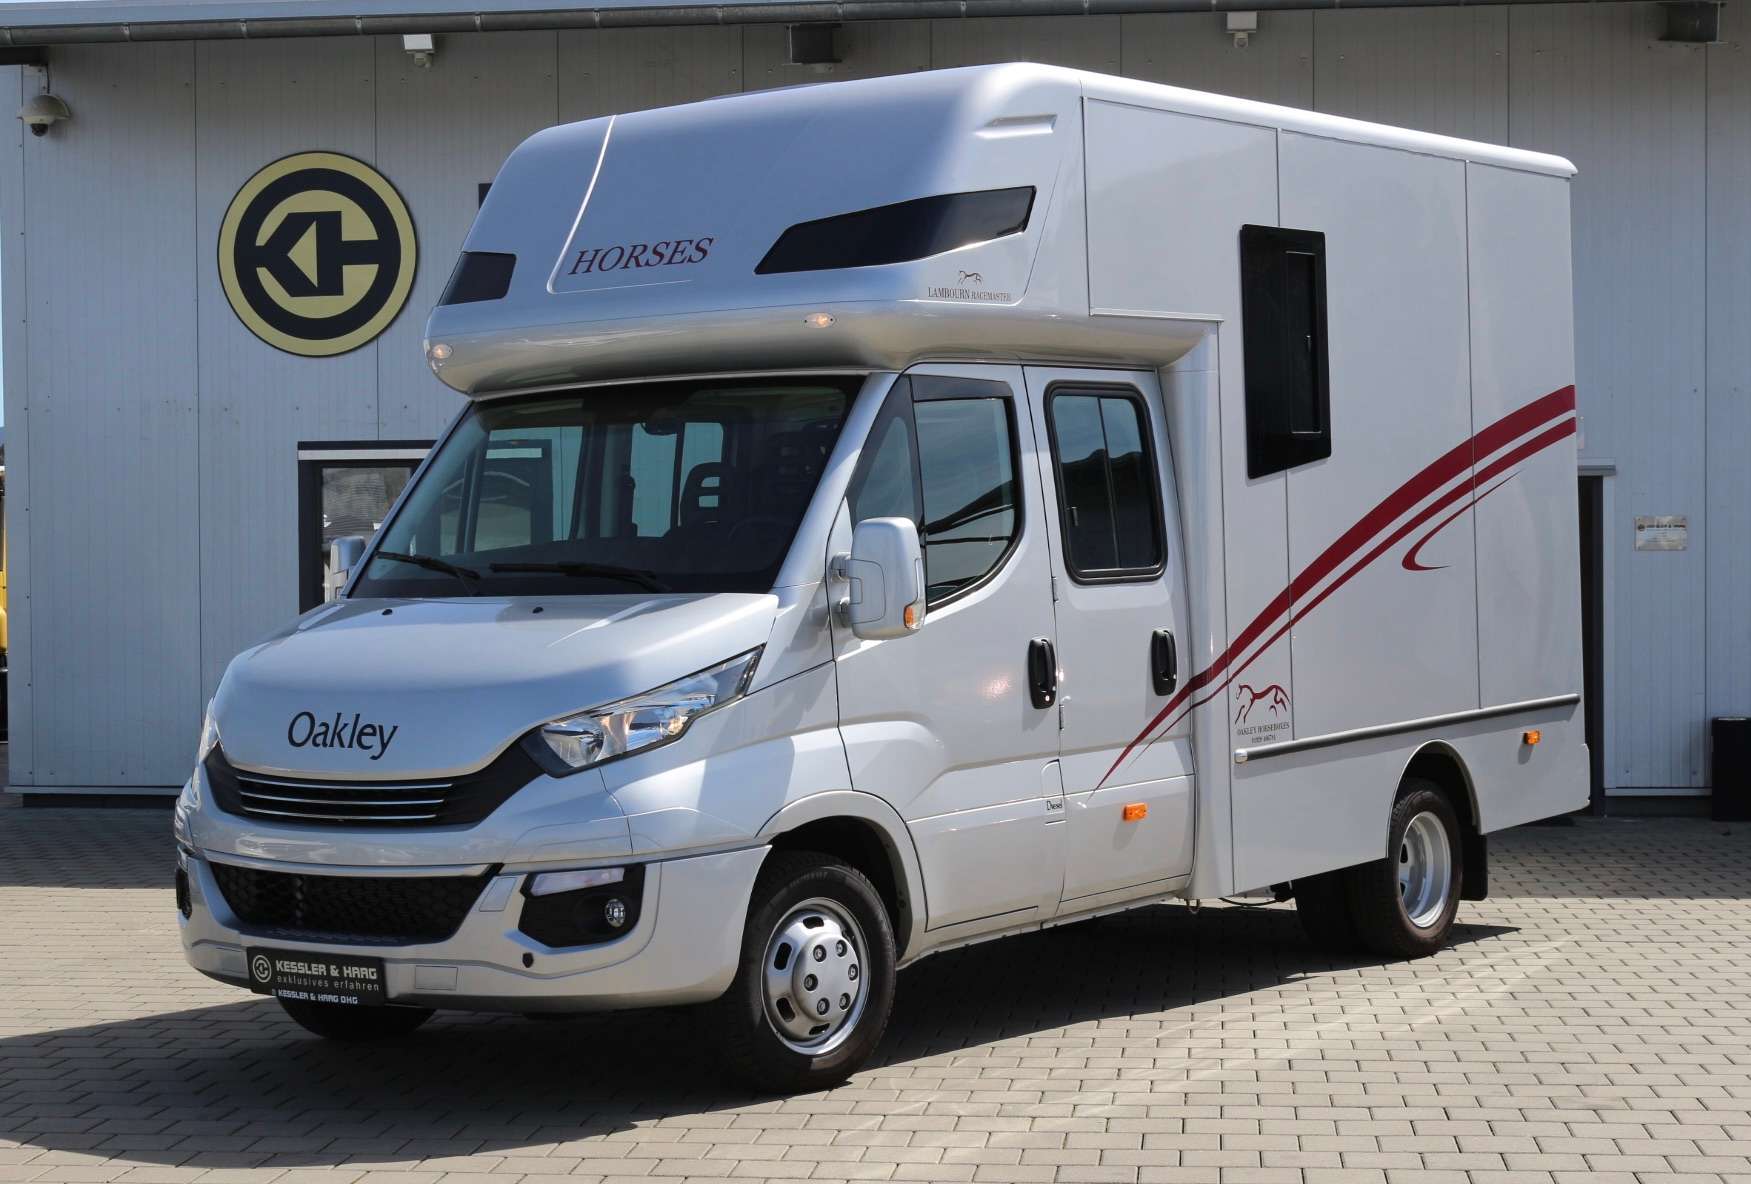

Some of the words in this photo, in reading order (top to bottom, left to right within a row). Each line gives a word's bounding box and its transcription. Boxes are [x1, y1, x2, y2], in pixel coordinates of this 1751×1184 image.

[567, 237, 714, 275] HORSES
[928, 286, 970, 300] LAMBOURN
[287, 711, 399, 761] Oakley
[1046, 799, 1063, 811] Diesel
[275, 959, 327, 976] KESSLER
[330, 964, 340, 977] &
[343, 965, 378, 980] HAAG
[276, 975, 330, 988] exklusives
[333, 979, 380, 992] erfahren
[278, 988, 309, 1001] KESSLER
[309, 992, 316, 1002] &
